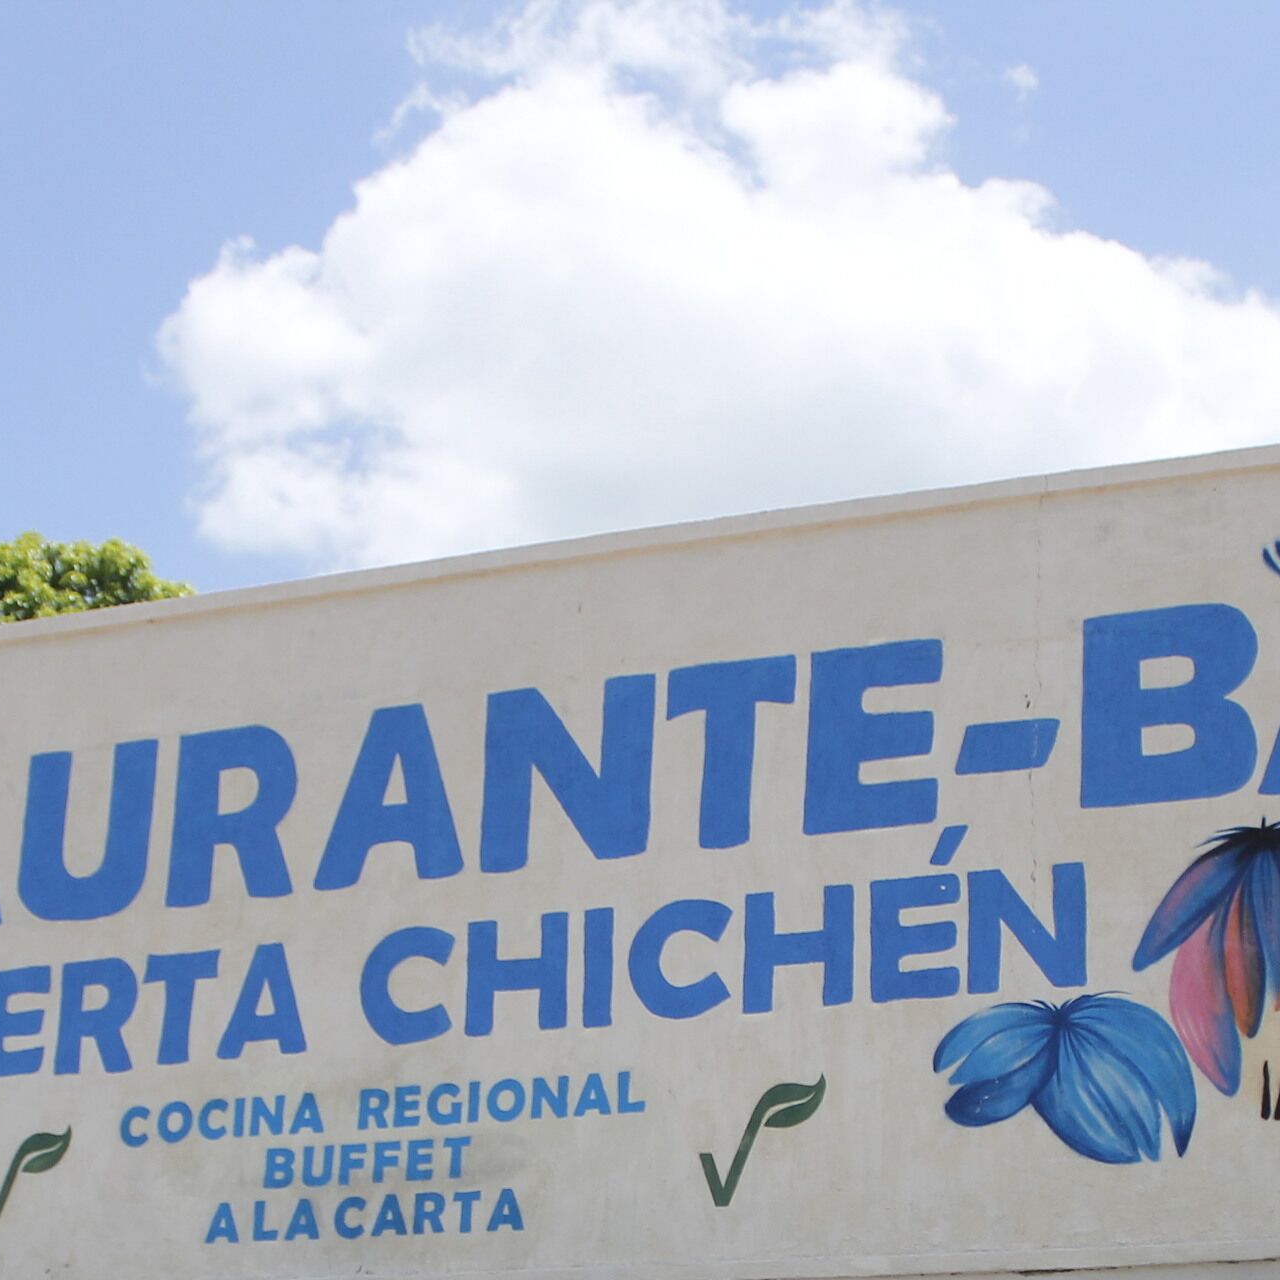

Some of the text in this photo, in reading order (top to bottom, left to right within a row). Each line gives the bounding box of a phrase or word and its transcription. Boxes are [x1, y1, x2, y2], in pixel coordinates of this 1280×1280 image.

[360, 824, 1088, 1045] CHICHÉN
[120, 1071, 646, 1147] COCINA REGIONAL
[263, 1135, 472, 1189] BUFFET
[334, 1188, 524, 1240] CARTA
